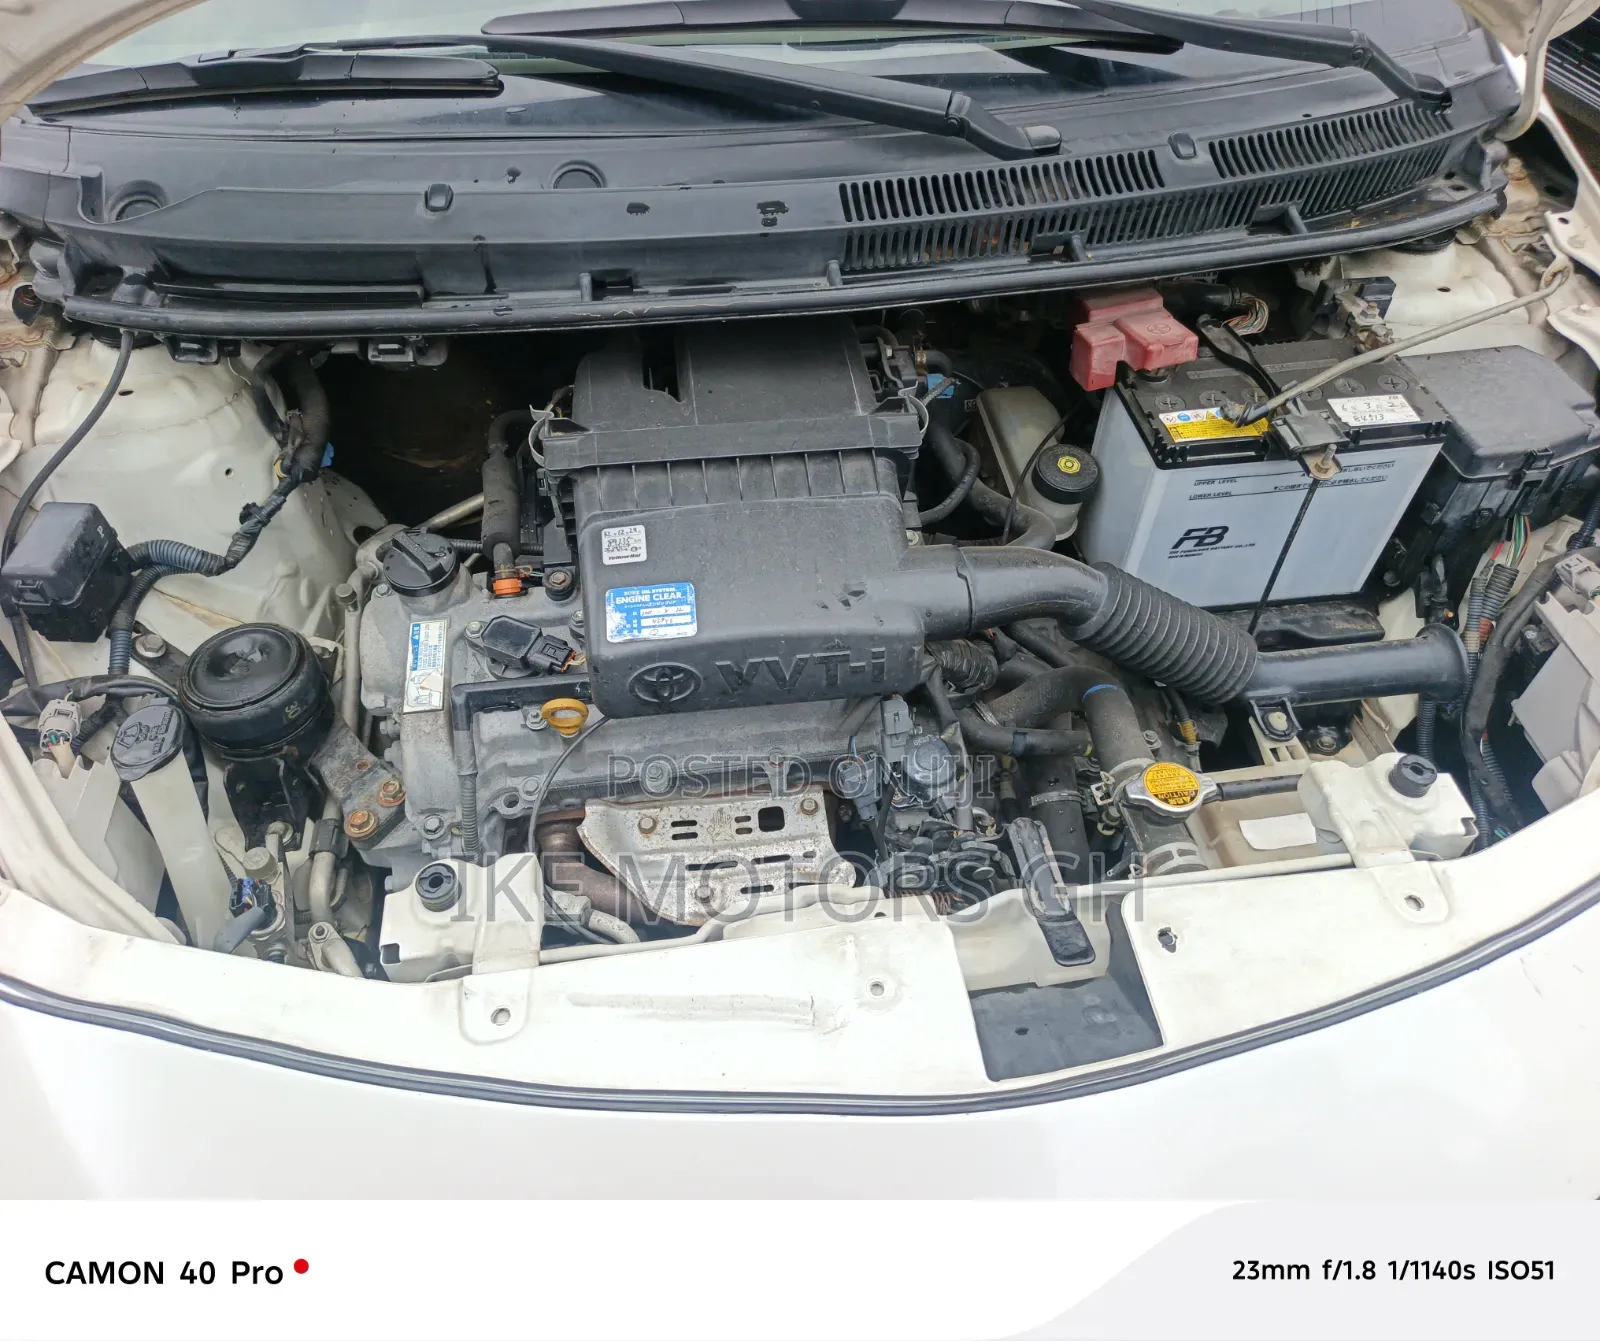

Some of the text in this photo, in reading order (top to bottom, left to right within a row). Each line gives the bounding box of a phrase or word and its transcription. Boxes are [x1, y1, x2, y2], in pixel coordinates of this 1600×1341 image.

[1171, 526, 1229, 550] FB
[616, 595, 650, 604] ENGINE
[653, 592, 682, 600] CLEAR
[715, 648, 887, 694] VVT-i
[1158, 790, 1195, 799] CAUTION
